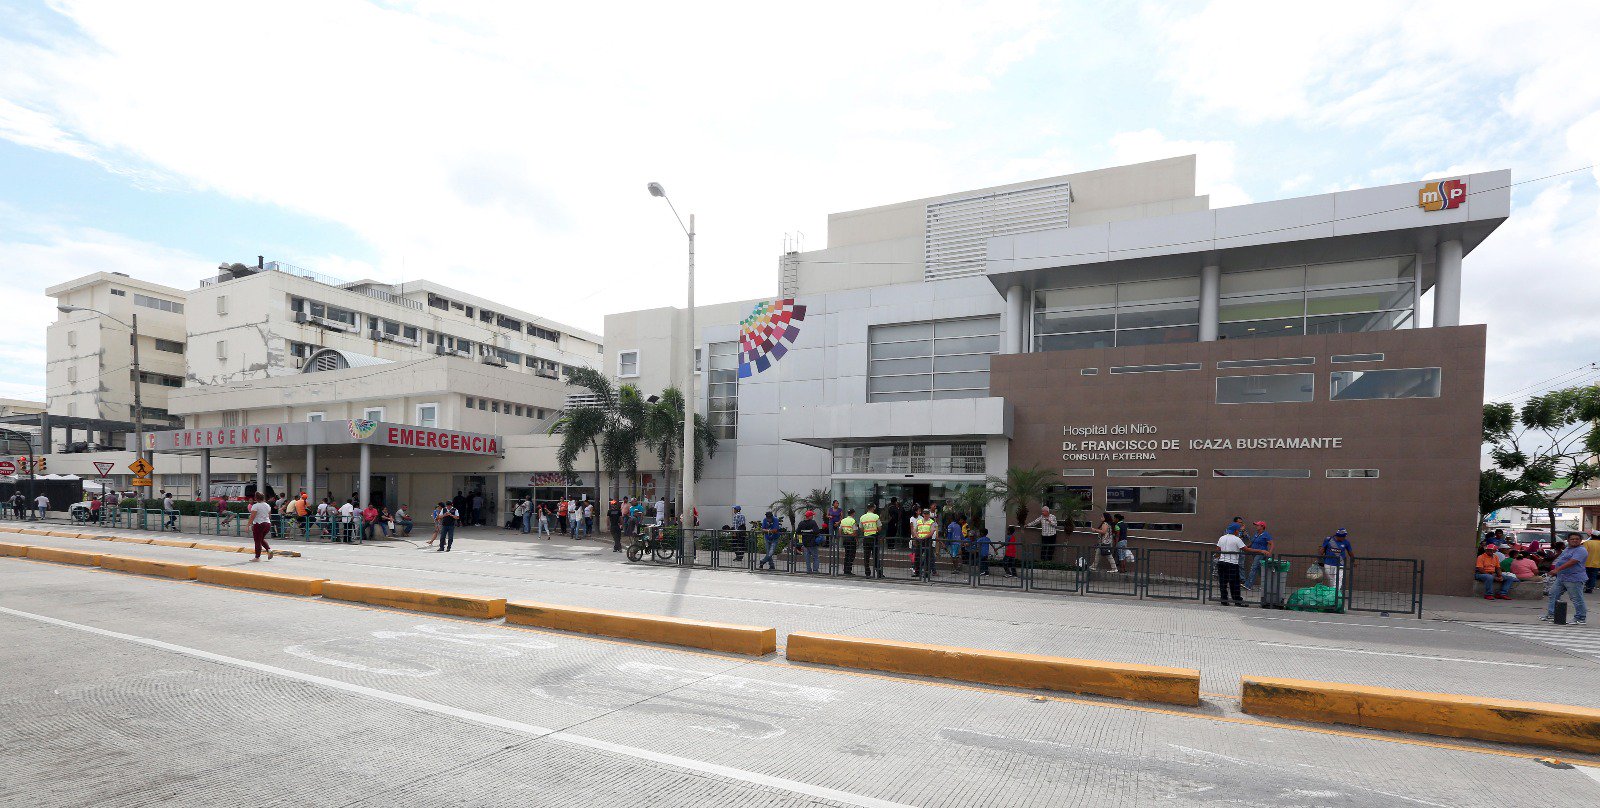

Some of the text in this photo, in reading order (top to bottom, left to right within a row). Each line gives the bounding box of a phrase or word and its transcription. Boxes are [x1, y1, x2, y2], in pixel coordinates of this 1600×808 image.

[174, 426, 283, 447] EMERGENCIA
[1063, 423, 1157, 437] Hospital del Niño
[388, 427, 497, 453] EMERGENCIA
[1062, 437, 1343, 451] Dr. FRANCISCO DE ICAZA BUSTAMANTE
[1062, 452, 1157, 461] CONSULTA EXTERNA
